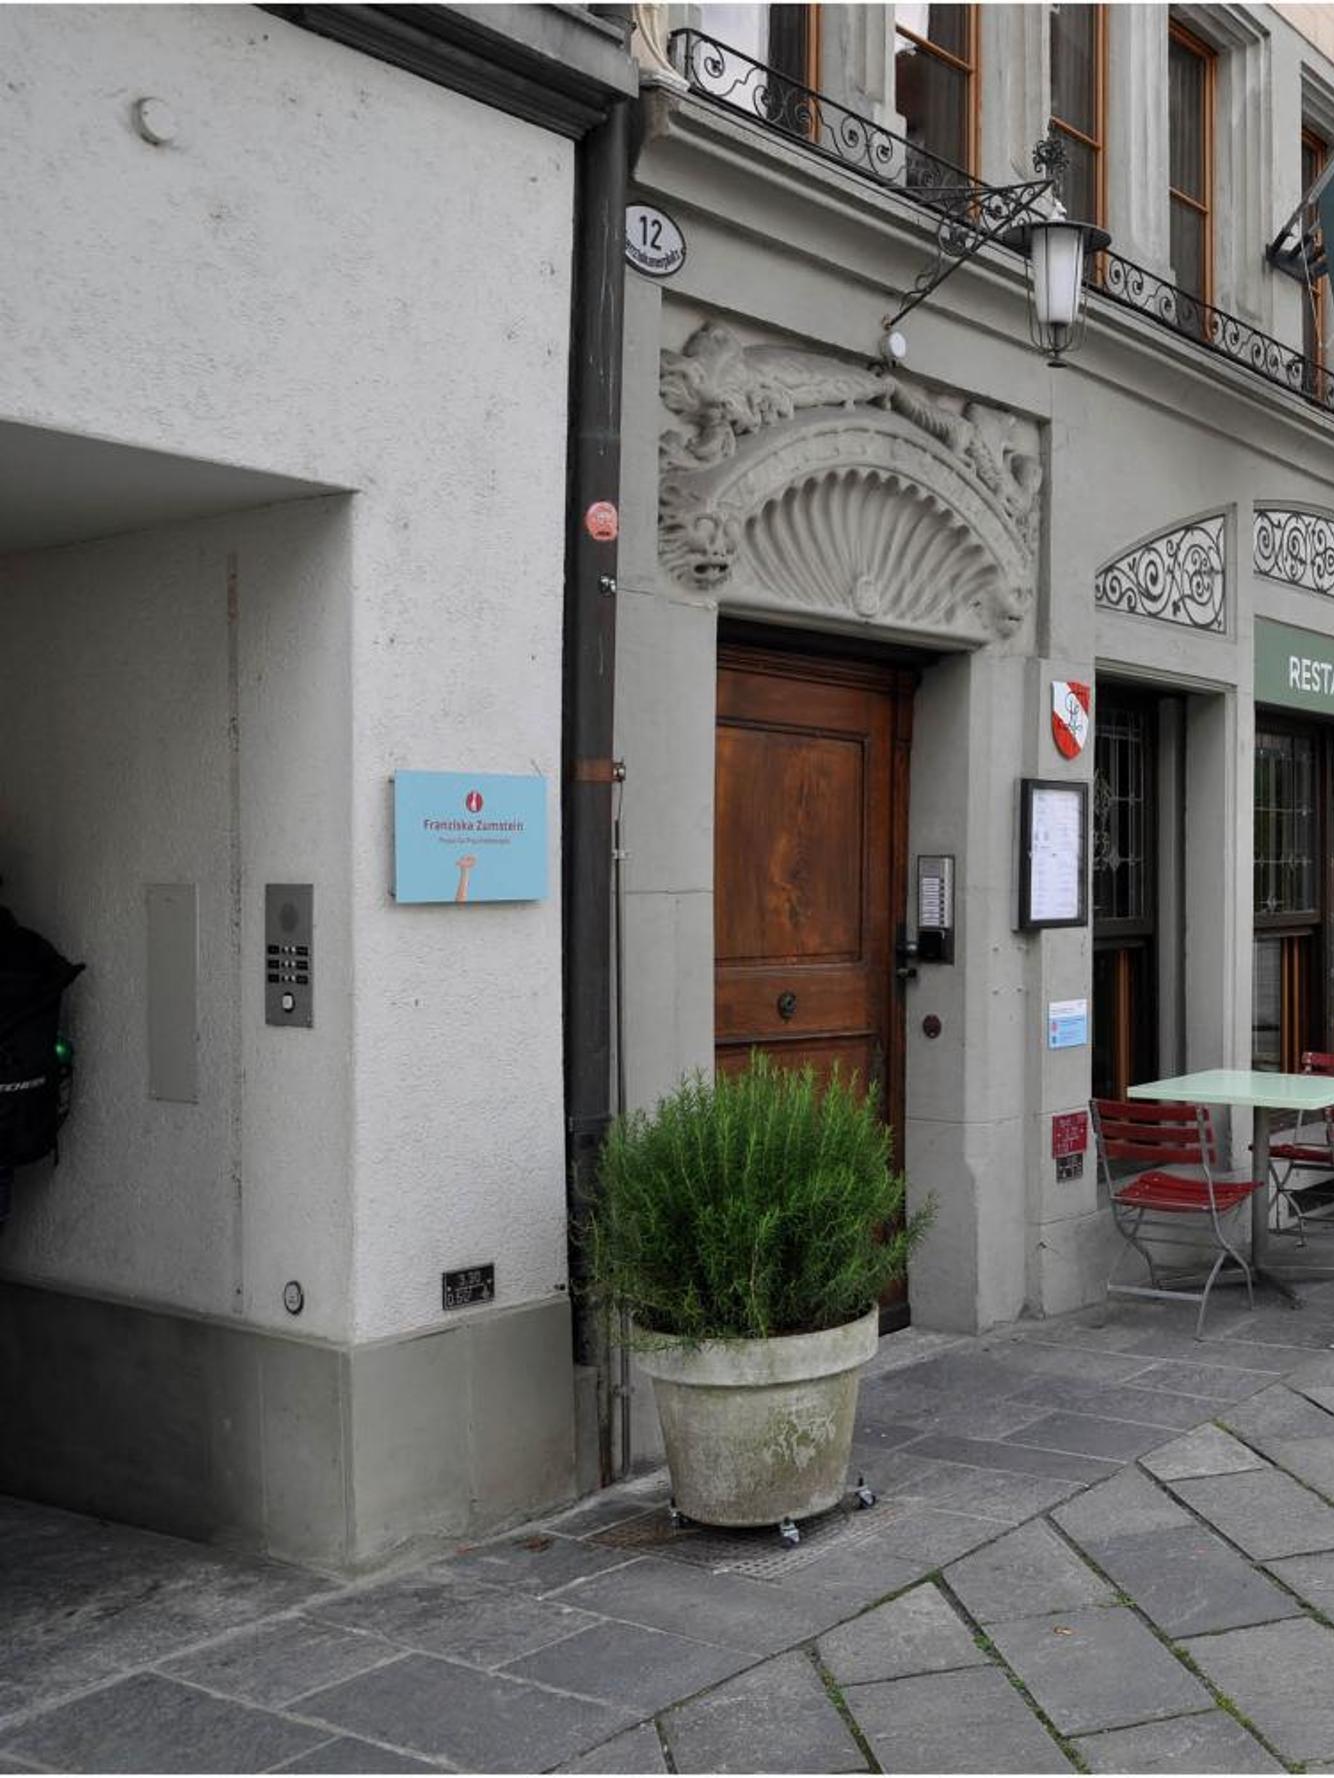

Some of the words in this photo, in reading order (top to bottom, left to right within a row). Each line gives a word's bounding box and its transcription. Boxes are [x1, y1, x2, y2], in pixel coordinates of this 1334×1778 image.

[639, 214, 662, 251] 12
[423, 819, 474, 831] Franziska
[476, 817, 524, 831] Zumstein
